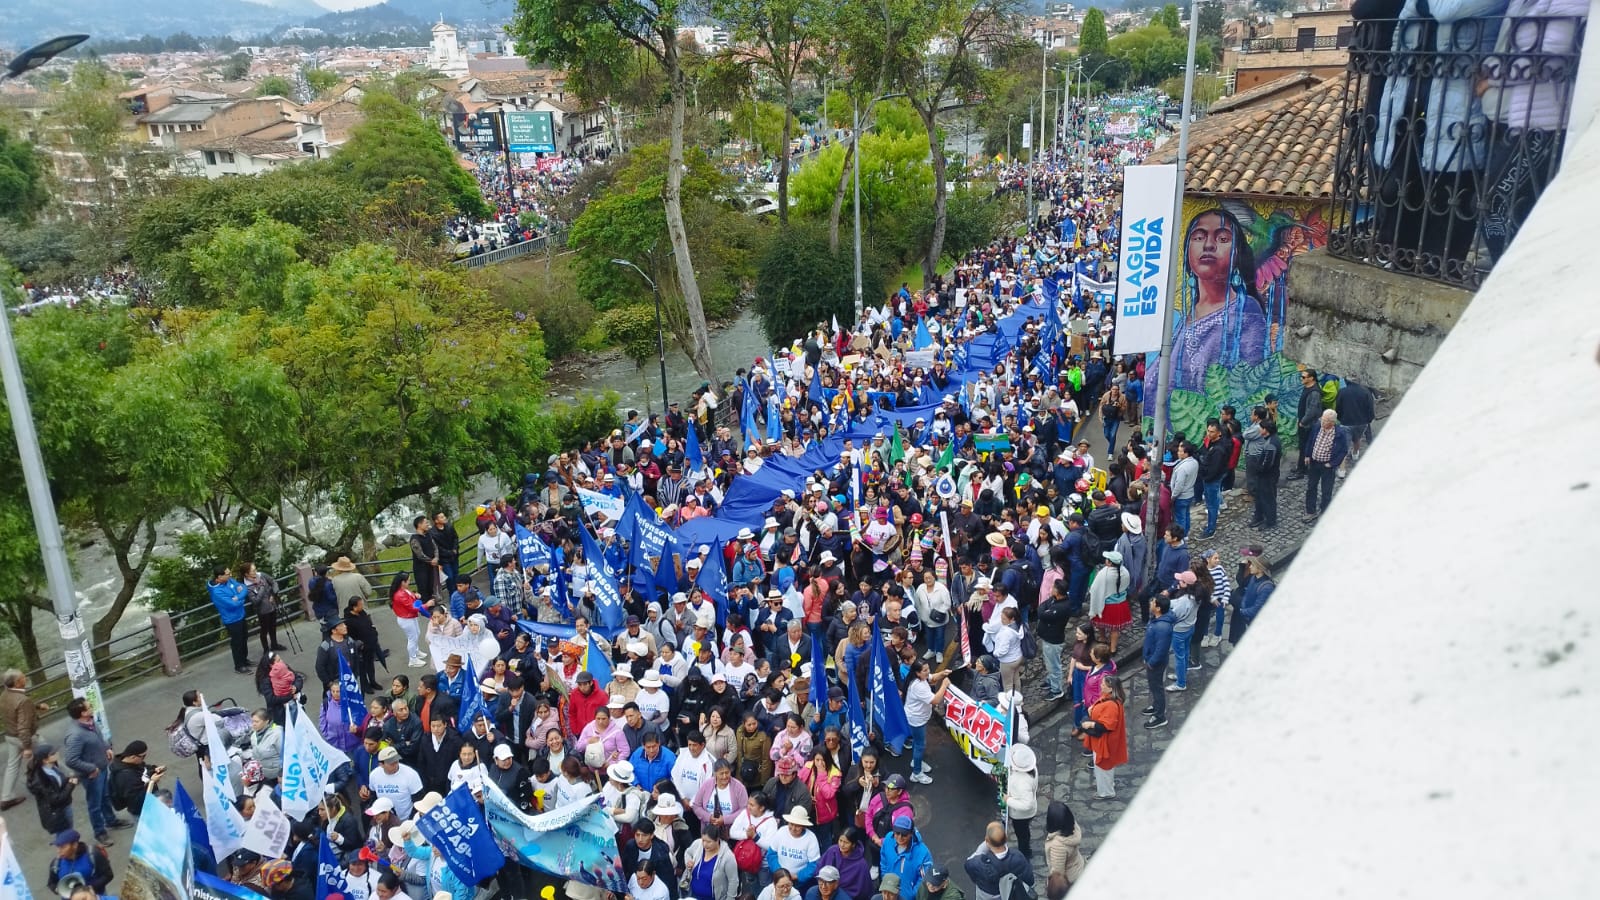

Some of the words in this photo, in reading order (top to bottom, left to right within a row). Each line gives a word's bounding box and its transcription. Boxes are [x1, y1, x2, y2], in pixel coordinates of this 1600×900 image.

[1125, 218, 1147, 287] AGUA
[1144, 217, 1164, 279] VIDA
[1123, 291, 1141, 316] EL
[1141, 285, 1158, 315] ES
